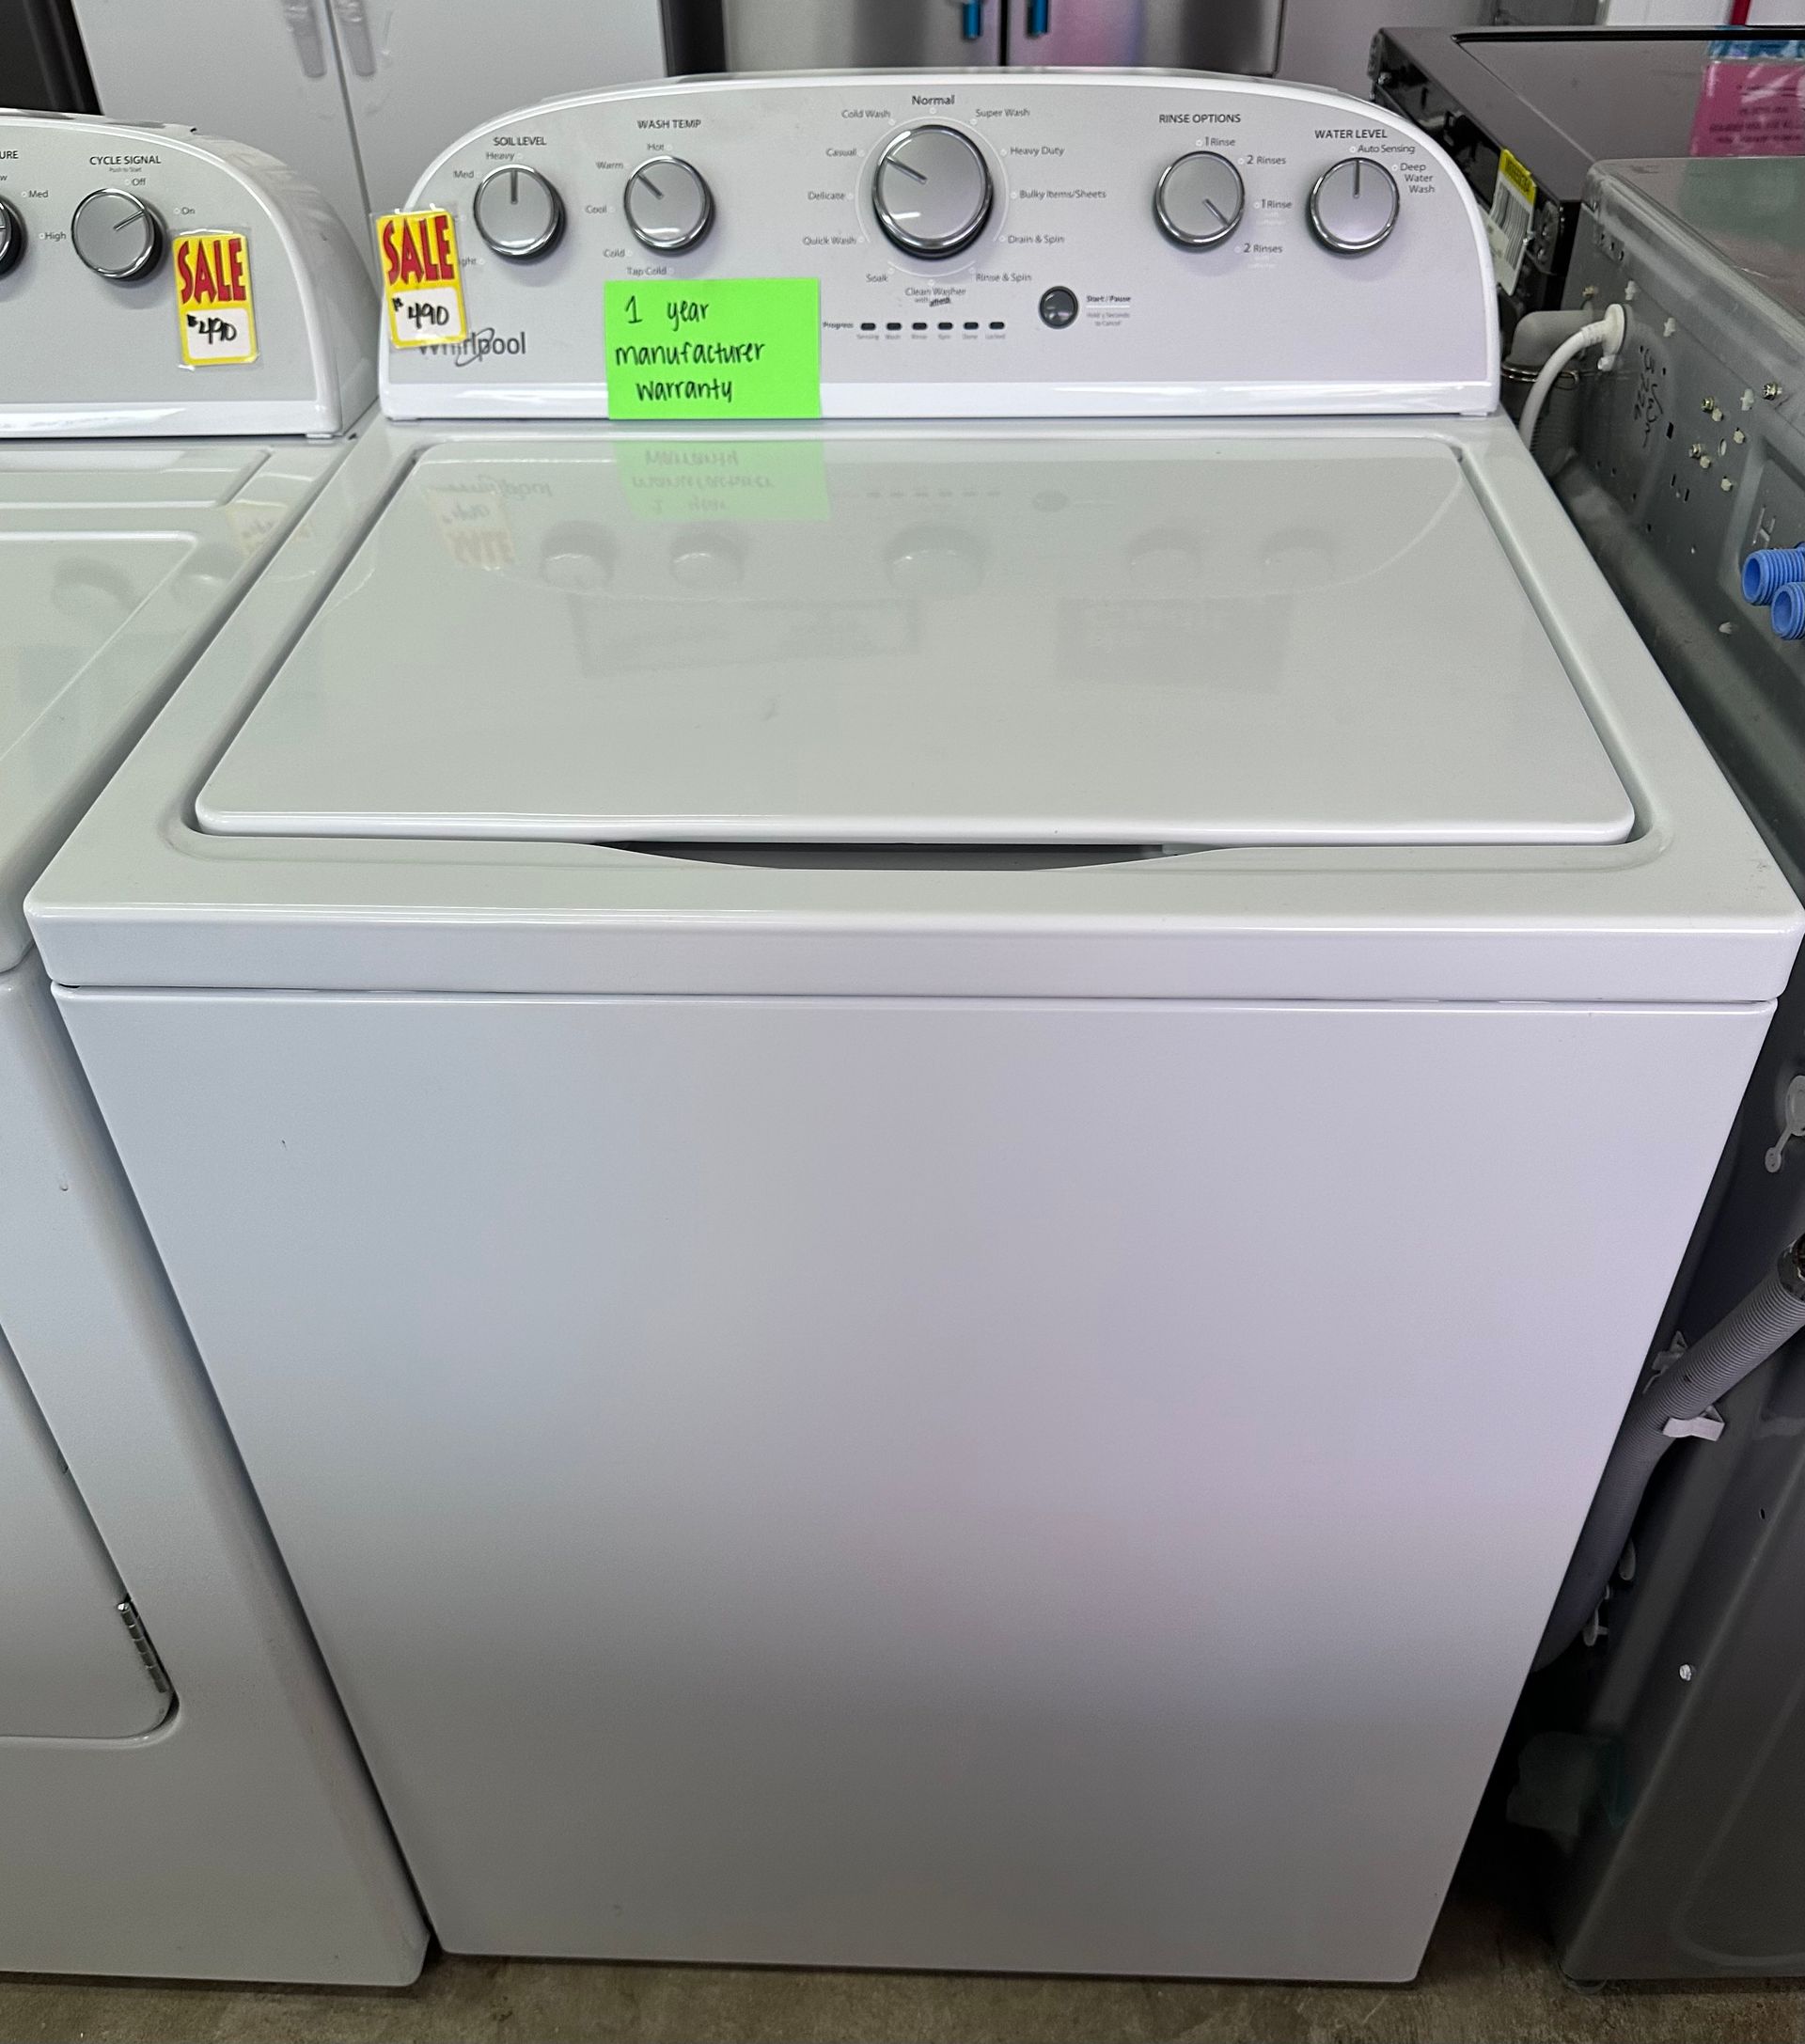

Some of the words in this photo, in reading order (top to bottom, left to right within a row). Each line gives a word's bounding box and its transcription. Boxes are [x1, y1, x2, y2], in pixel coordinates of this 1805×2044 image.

[911, 95, 955, 105] Normal
[841, 110, 864, 118] Cold
[866, 109, 891, 118] Wash
[975, 109, 1003, 118] Super
[1004, 108, 1030, 117] Wash
[1158, 114, 1190, 123] RINSE
[1192, 114, 1241, 123] OPTIONS
[636, 119, 671, 130] WASH
[672, 119, 702, 129] TEMP
[1314, 130, 1354, 139] WATER
[1355, 129, 1389, 139] LEVEL
[493, 136, 516, 147] SOIL
[518, 136, 547, 146] LEVEL
[1210, 137, 1236, 147] Rinse
[647, 143, 665, 151] Hot
[1010, 147, 1040, 157] Heavy
[1041, 147, 1065, 157] Duty
[1357, 144, 1380, 153] Auto
[1380, 144, 1416, 154] Sensing
[485, 151, 515, 161] Heavy
[825, 149, 857, 157] Casual
[89, 156, 122, 165] CYCLE
[123, 155, 162, 165] SIGNAL
[1247, 154, 1254, 165] 2
[1256, 155, 1287, 165] Rinses
[596, 162, 624, 170] Warm
[1400, 163, 1427, 172] Deep
[453, 170, 474, 179] Med
[1404, 174, 1434, 182] Water
[132, 178, 146, 186] Off
[28, 190, 49, 198] Med
[1408, 184, 1436, 194] Wash
[807, 191, 845, 200] Delicate
[1019, 190, 1046, 200] Bulky
[1046, 189, 1107, 199] Items/Sheets
[585, 205, 607, 213] Cool
[1266, 200, 1293, 209] Rinse
[180, 207, 196, 215] On
[45, 232, 67, 242] High
[802, 237, 829, 246] Quick
[831, 237, 856, 245] Wash
[1007, 235, 1033, 244] Drain
[1035, 235, 1043, 244] &
[1044, 235, 1065, 245] Spin
[383, 214, 455, 286] SALE
[1243, 243, 1250, 253] 2
[1252, 244, 1283, 253] Rinses
[603, 249, 625, 258] Cold
[178, 238, 246, 304] SALE
[627, 267, 644, 276] Tap
[645, 266, 667, 275] Cold
[865, 274, 888, 282] Soak
[975, 273, 1001, 281] Rinse
[1002, 273, 1010, 281] &
[1011, 273, 1031, 283] Spin
[904, 287, 931, 296] Clean
[933, 287, 966, 297] Washer
[624, 295, 643, 324] 1
[666, 300, 710, 332] year
[616, 340, 766, 367] manufacturer
[636, 378, 733, 403] warranty
